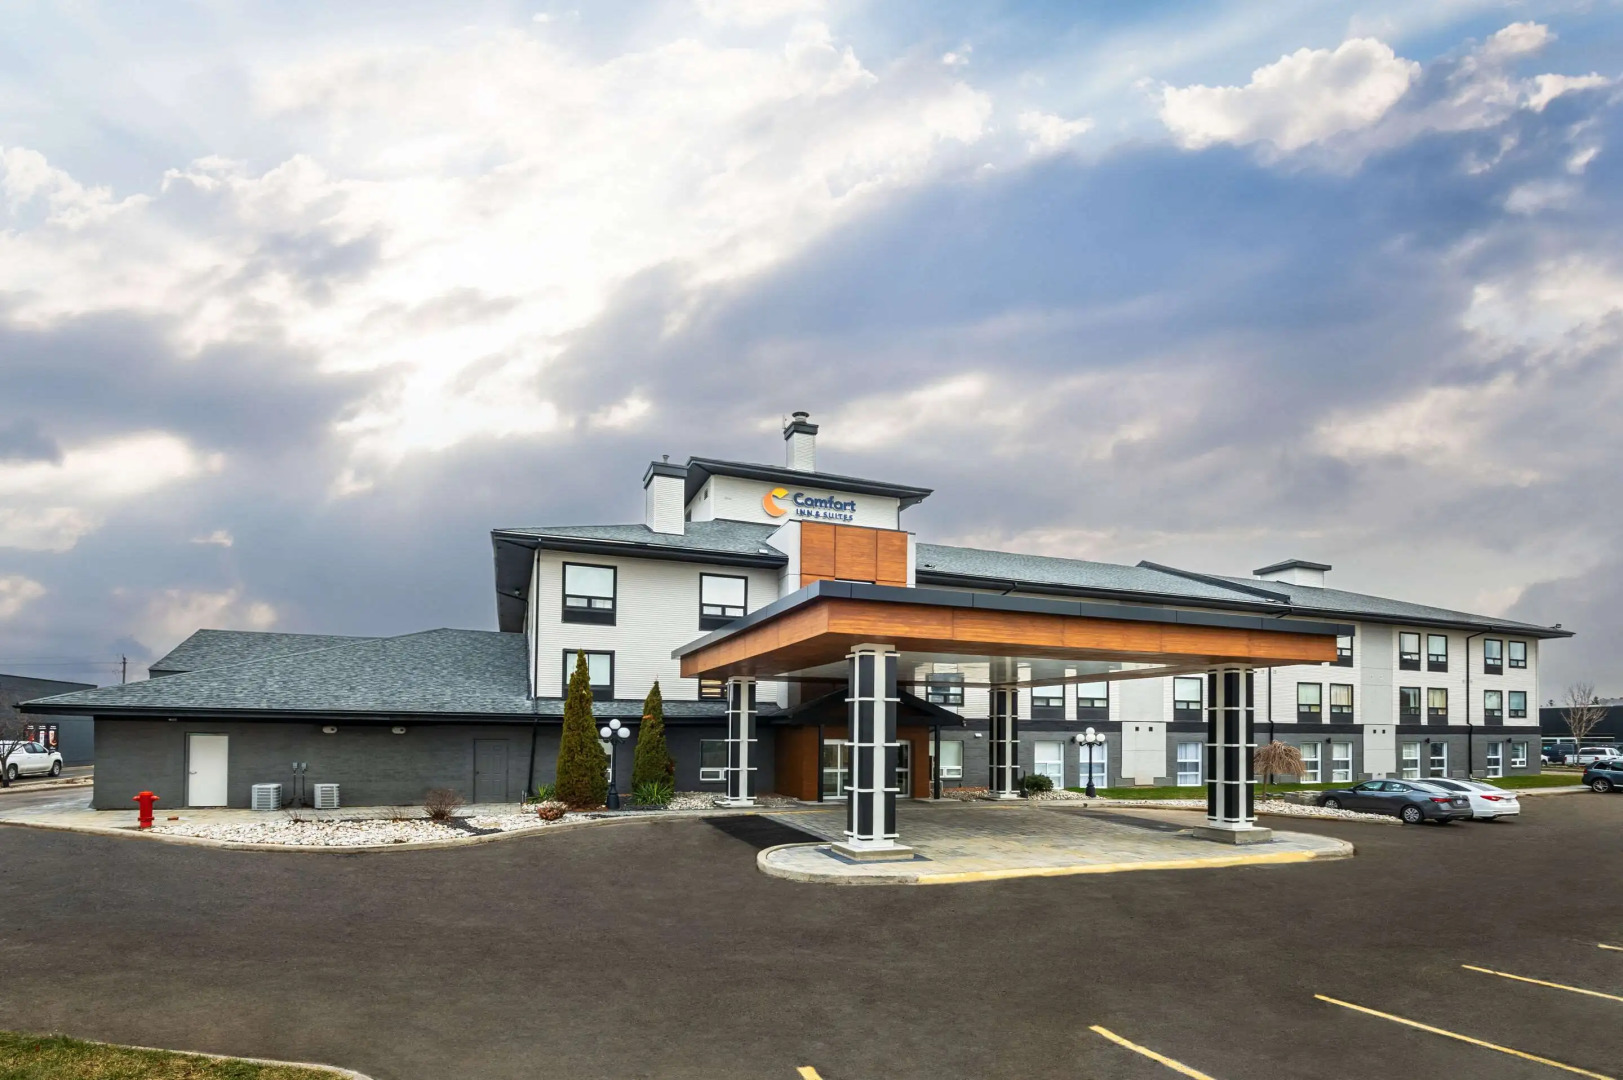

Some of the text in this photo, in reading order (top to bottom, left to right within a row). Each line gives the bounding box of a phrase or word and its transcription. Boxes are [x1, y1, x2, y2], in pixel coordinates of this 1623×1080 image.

[793, 492, 856, 512] Comfort
[796, 508, 813, 516] INN
[823, 511, 853, 521] SUITES
